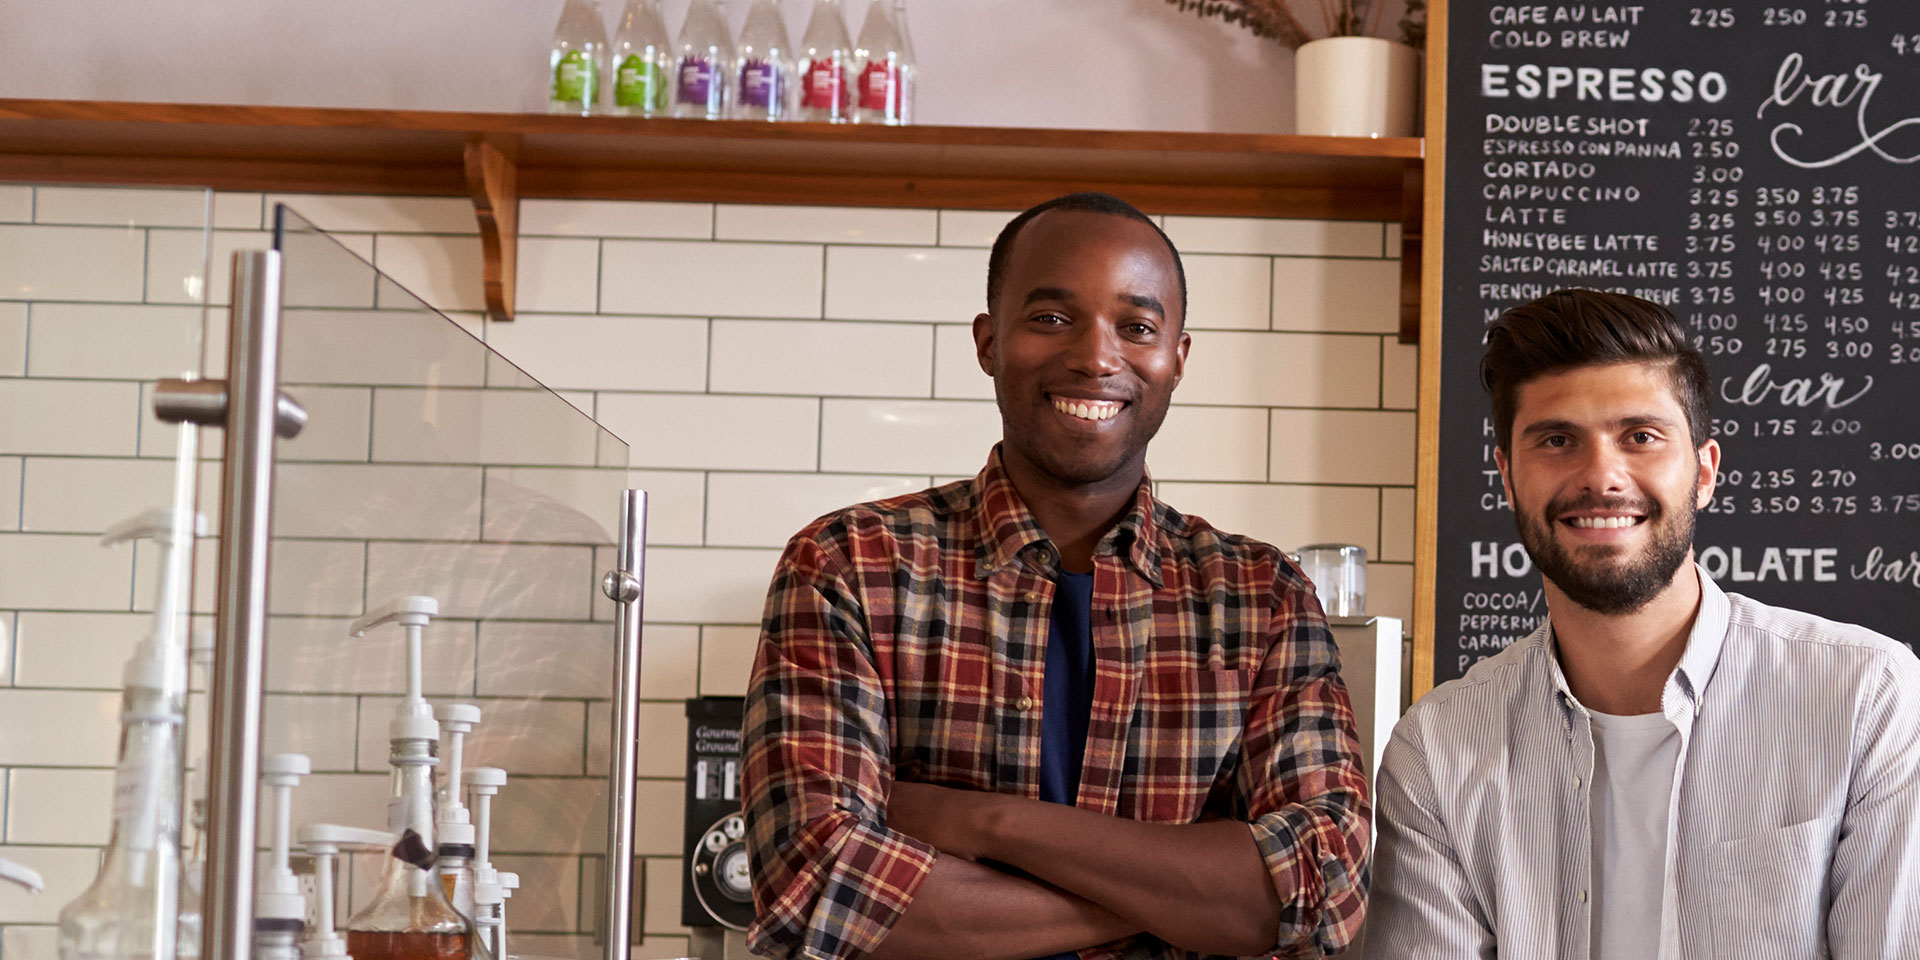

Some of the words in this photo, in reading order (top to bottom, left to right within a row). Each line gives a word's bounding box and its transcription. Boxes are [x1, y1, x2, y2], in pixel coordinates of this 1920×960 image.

[1490, 6, 1548, 25] CAFE
[1554, 5, 1585, 22] AU
[1592, 6, 1644, 25] LAIT
[1490, 30, 1551, 47] COLD
[1561, 30, 1630, 48] BREW
[1481, 64, 1727, 103] ESPRESSO
[1757, 53, 1890, 142] bar
[1486, 114, 1580, 134] DOUBLE
[1585, 117, 1649, 137] SHOT
[1484, 139, 1574, 155] ESPRESSO
[1579, 141, 1610, 156] CON
[1615, 141, 1681, 159] PANNA
[1483, 161, 1595, 178] CORTADO
[1483, 184, 1640, 202] CAPPUCCINO
[1812, 186, 1858, 205] 3.75
[1486, 206, 1565, 225] LATTE
[1885, 211, 1920, 229] 3.7
[1483, 229, 1586, 250] HONEYBEE
[1594, 234, 1658, 251] LATTE
[1480, 255, 1544, 273] SALTED
[1546, 259, 1623, 277] CARAMEL
[1627, 262, 1677, 278] LATTE
[1478, 283, 1542, 301] FRENCH
[1721, 363, 1874, 409] bar
[1754, 419, 1796, 437] 1.75
[1811, 419, 1861, 435] 2.00
[1870, 442, 1920, 460] 3.00
[1751, 469, 1795, 489] 2.35
[1811, 469, 1856, 487] 2.70
[1751, 496, 1800, 513] 3.50
[1811, 496, 1856, 515] 3.75
[1470, 540, 1532, 579] HO
[1700, 545, 1838, 582] OLATE
[1457, 633, 1525, 651] CARAM
